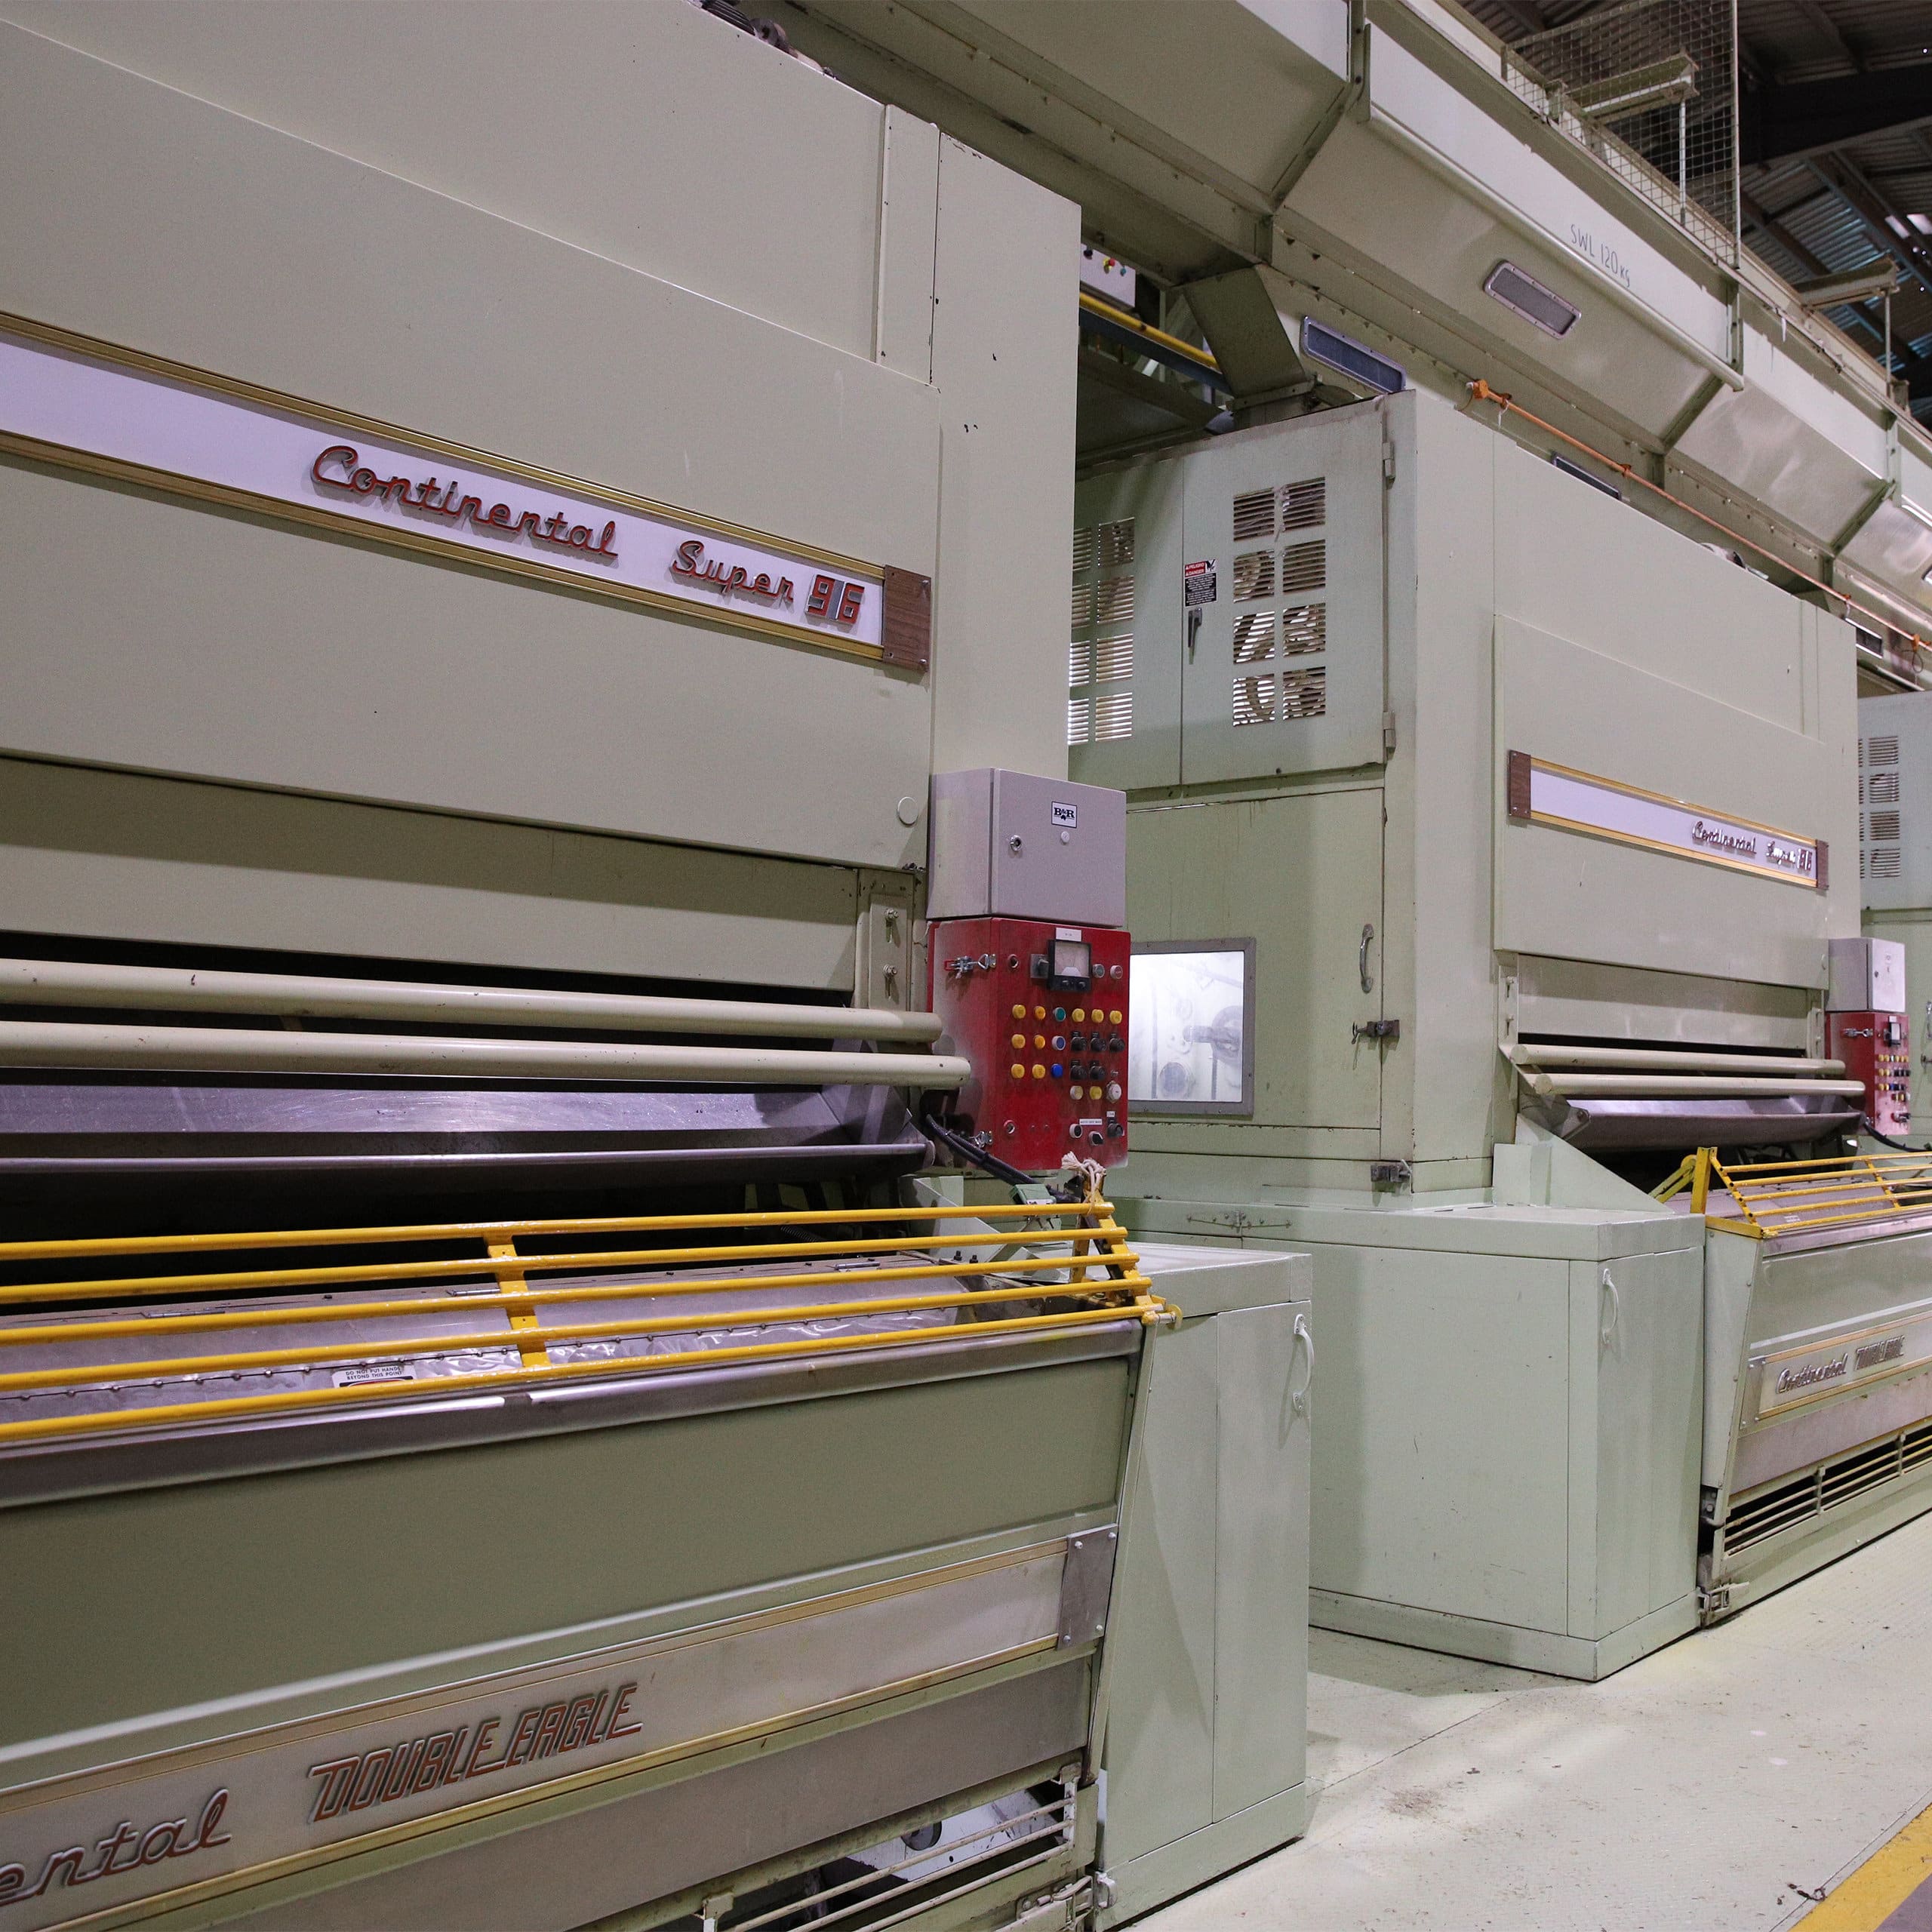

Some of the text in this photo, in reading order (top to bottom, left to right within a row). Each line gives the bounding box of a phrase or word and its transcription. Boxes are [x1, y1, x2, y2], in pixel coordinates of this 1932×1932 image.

[1571, 223, 1595, 257] SWL
[310, 445, 866, 625] Continental Super 96
[308, 1683, 644, 1823] DOUBLE EAGLE
[0, 1789, 232, 1906] ental
